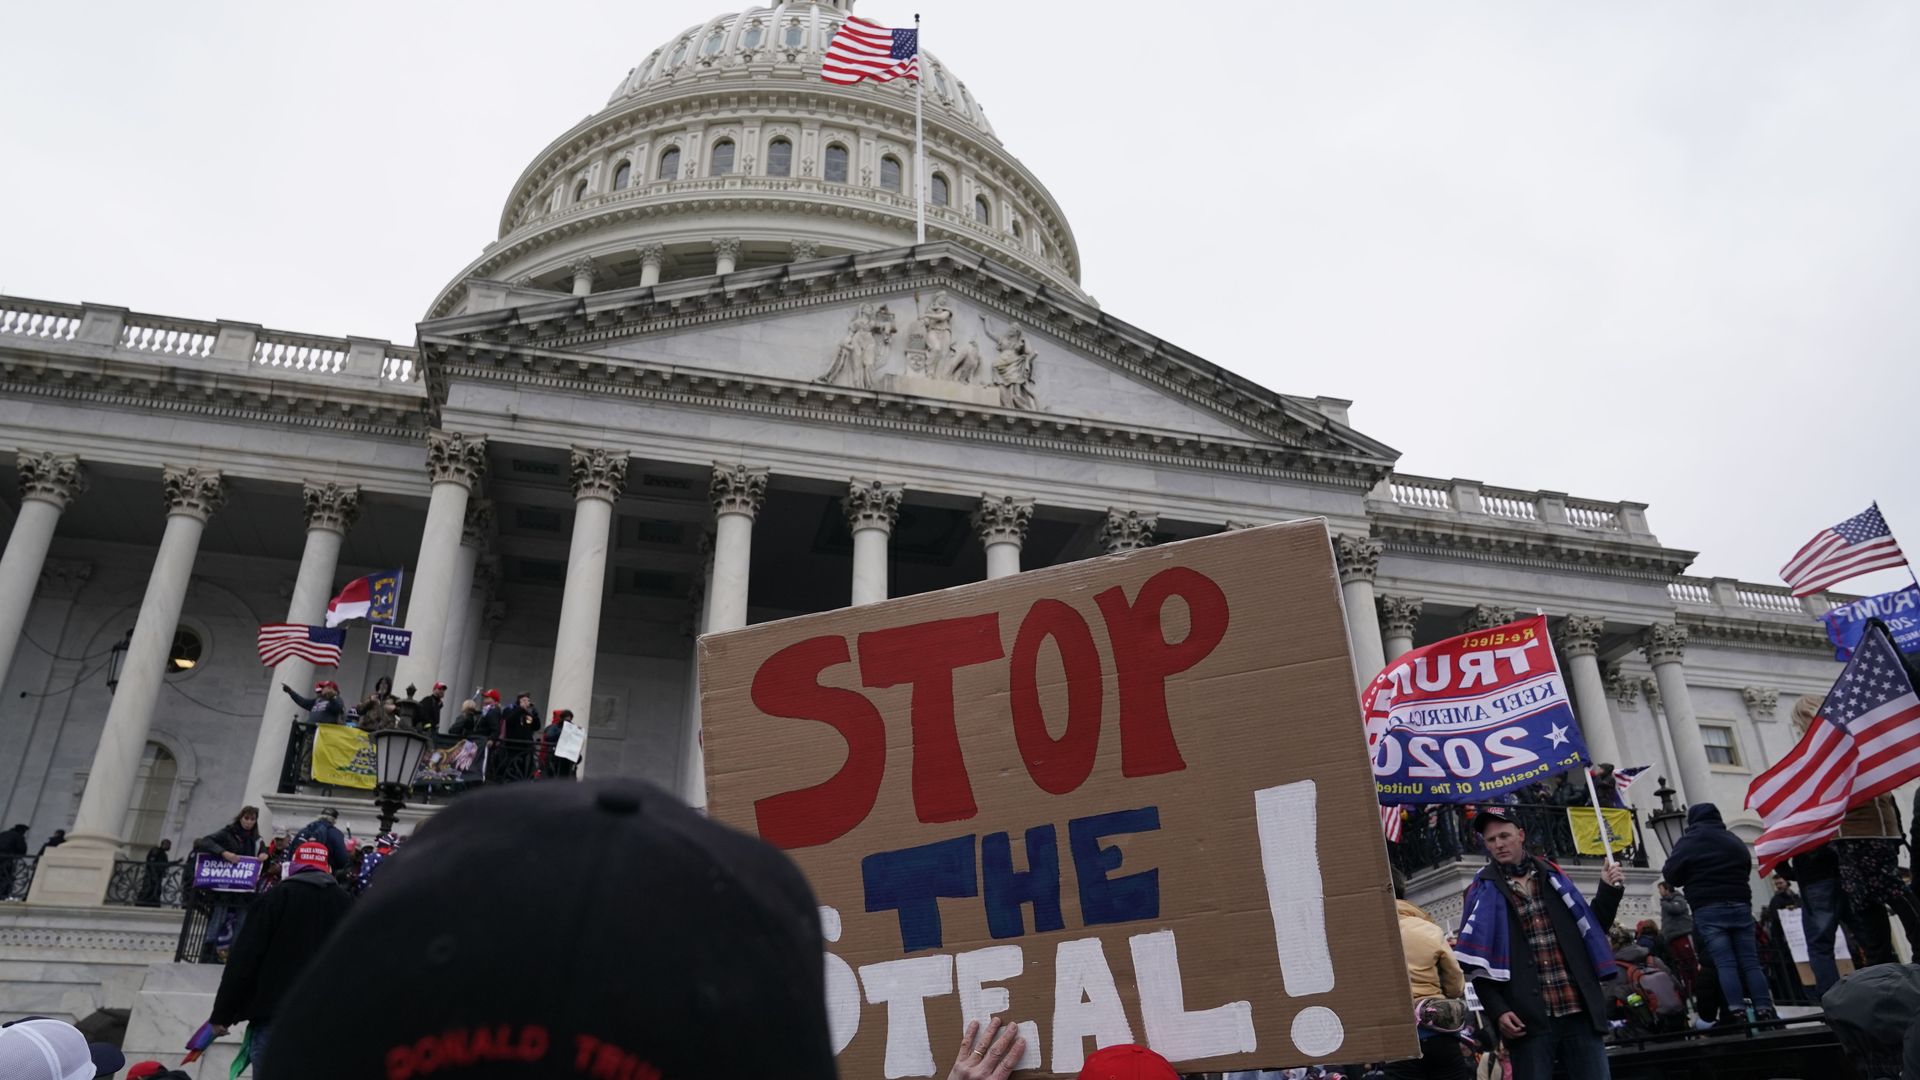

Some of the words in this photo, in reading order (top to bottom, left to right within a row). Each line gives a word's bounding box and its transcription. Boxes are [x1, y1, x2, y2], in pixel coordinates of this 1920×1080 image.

[373, 632, 410, 643] TRUMP
[750, 566, 1229, 849] STOP
[203, 859, 233, 869] DRAIN
[236, 861, 256, 871] THE
[201, 867, 254, 879] SWAMP
[861, 806, 1161, 953] THE
